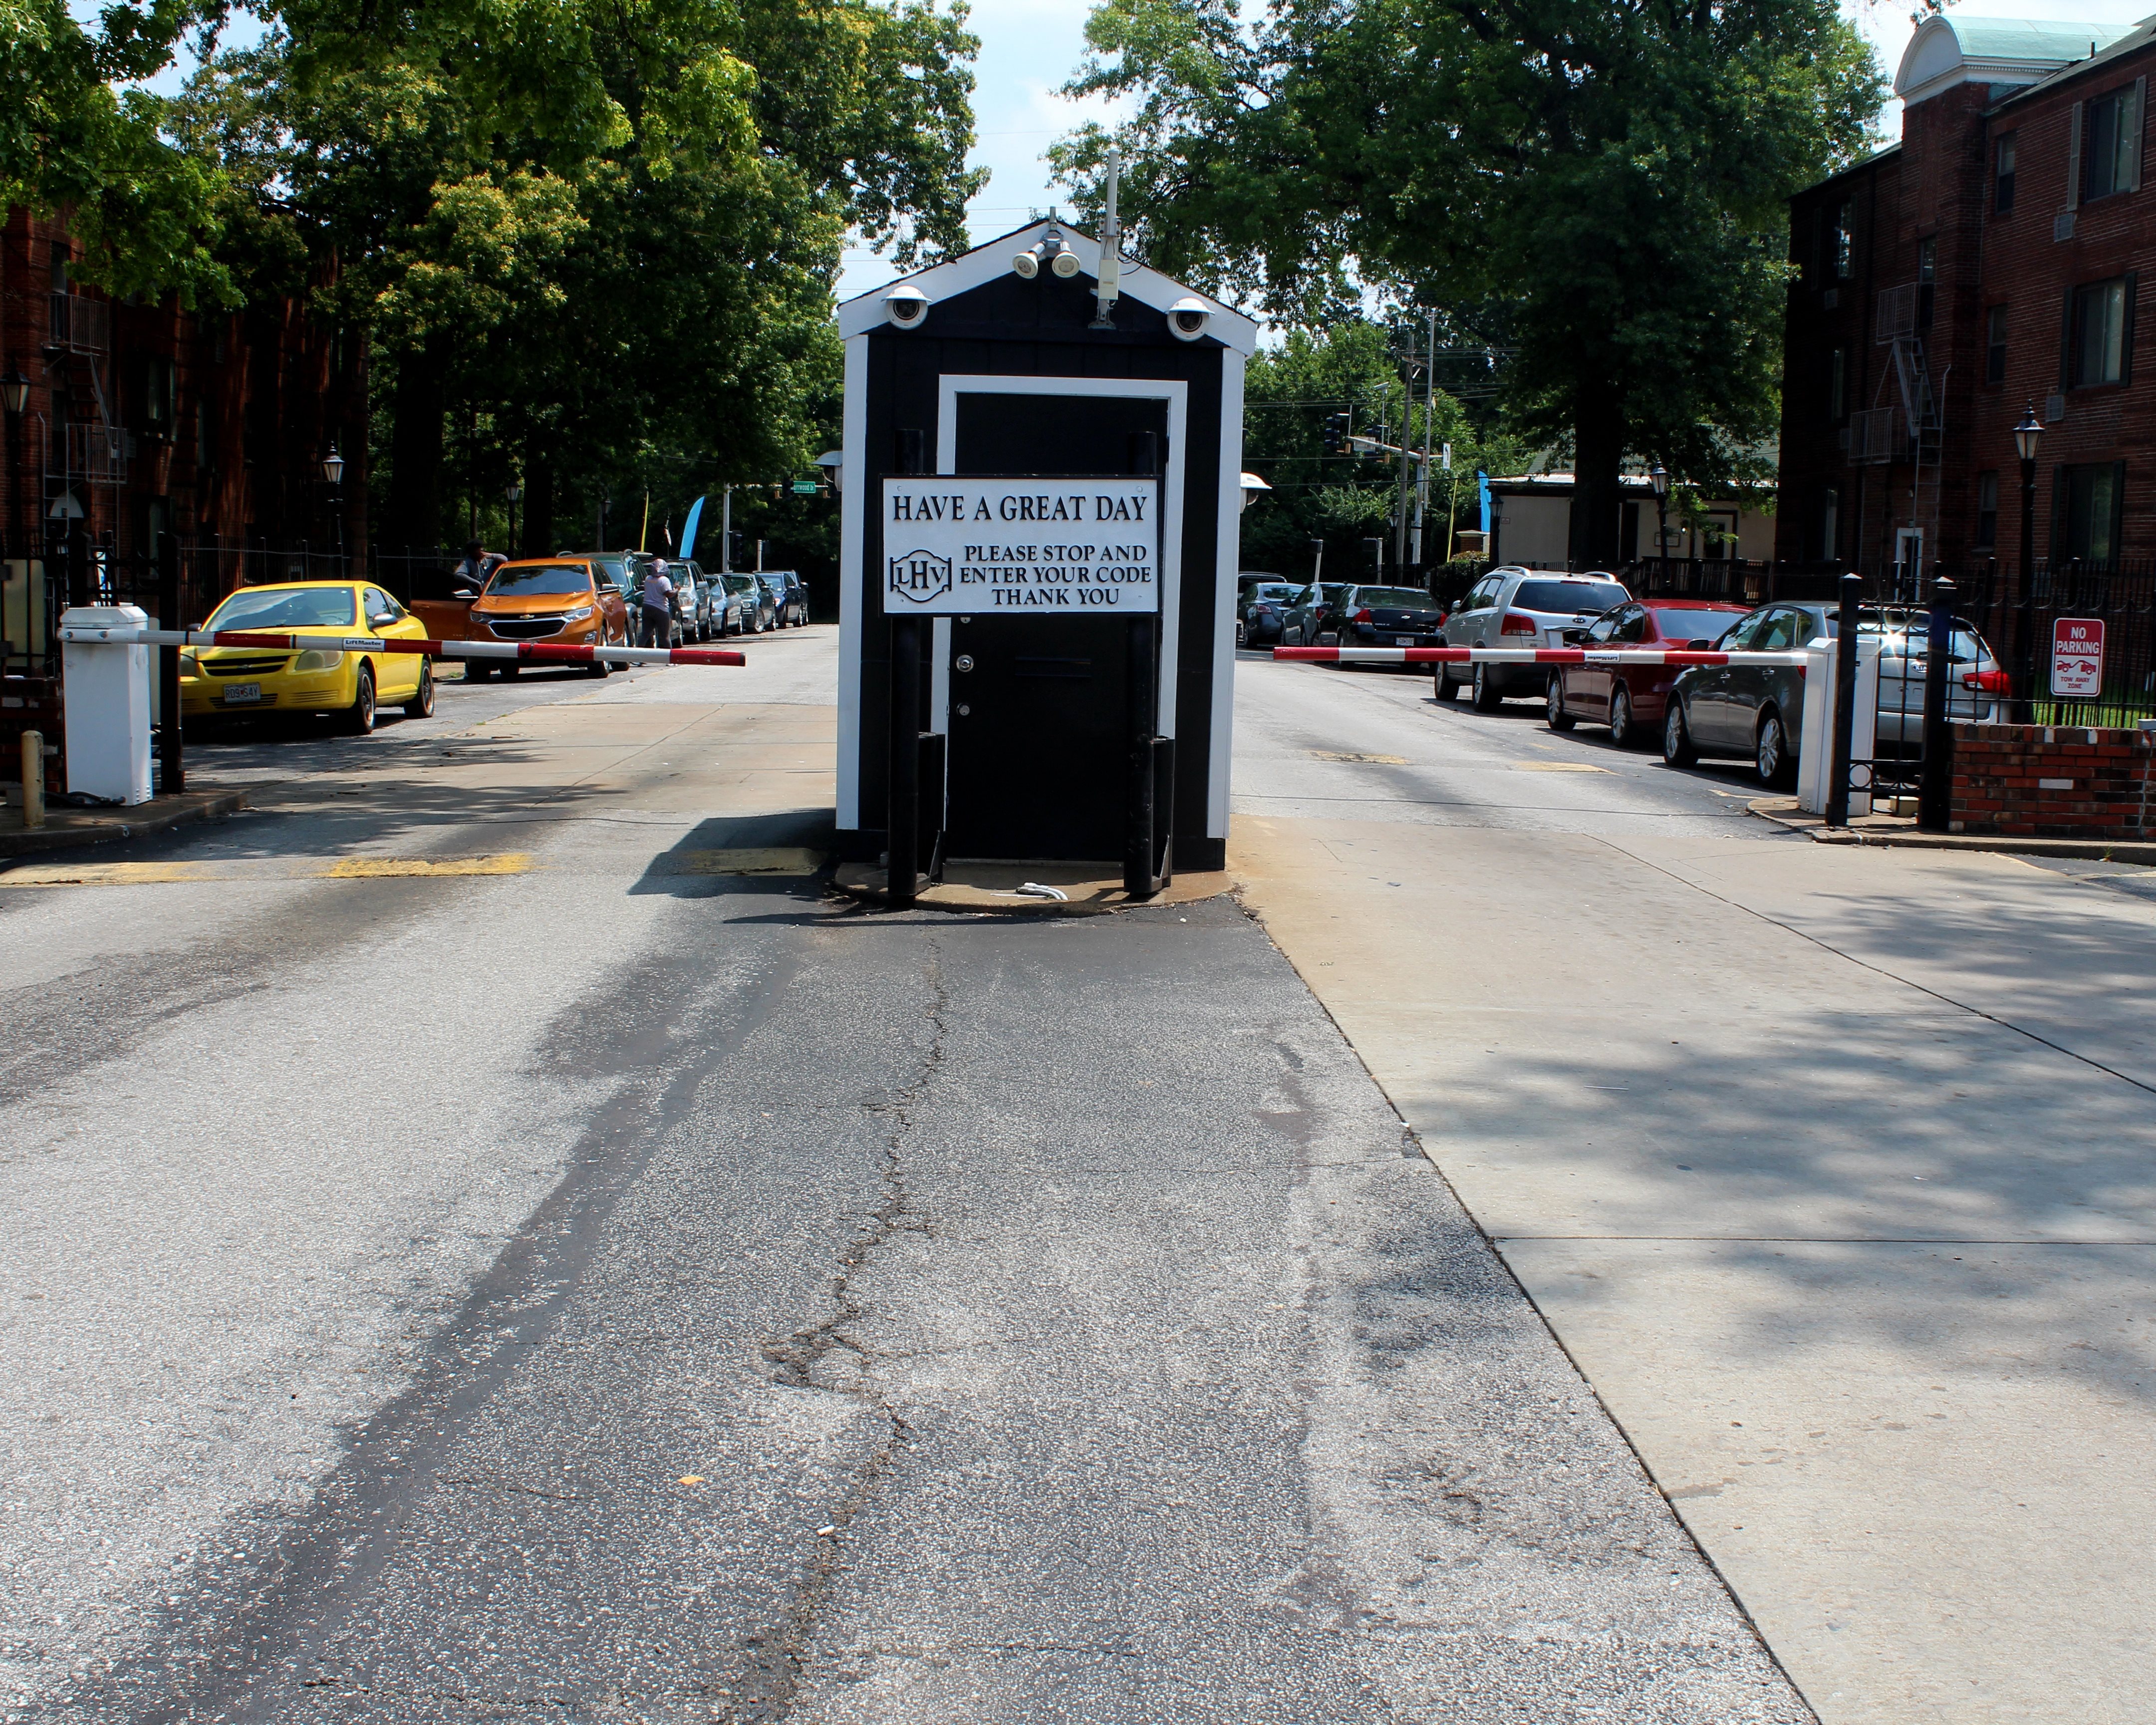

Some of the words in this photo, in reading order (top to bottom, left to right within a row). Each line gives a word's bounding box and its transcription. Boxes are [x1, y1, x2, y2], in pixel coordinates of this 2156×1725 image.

[893, 496, 965, 521] HAVE
[974, 496, 992, 521] A
[1000, 496, 1086, 521] GREAT
[1095, 496, 1147, 521] DAY
[964, 545, 1038, 562] PLEASE
[1044, 545, 1095, 561] STOP
[1099, 545, 1147, 561] AND
[896, 560, 946, 589] LHV
[960, 567, 1028, 583] ENTER
[1033, 567, 1090, 583] YOUR
[1096, 567, 1151, 583] CODE
[992, 588, 1070, 605] THANK
[1077, 588, 1119, 605] YOU
[2071, 627, 2086, 639] NO
[2056, 640, 2100, 654] PARKING
